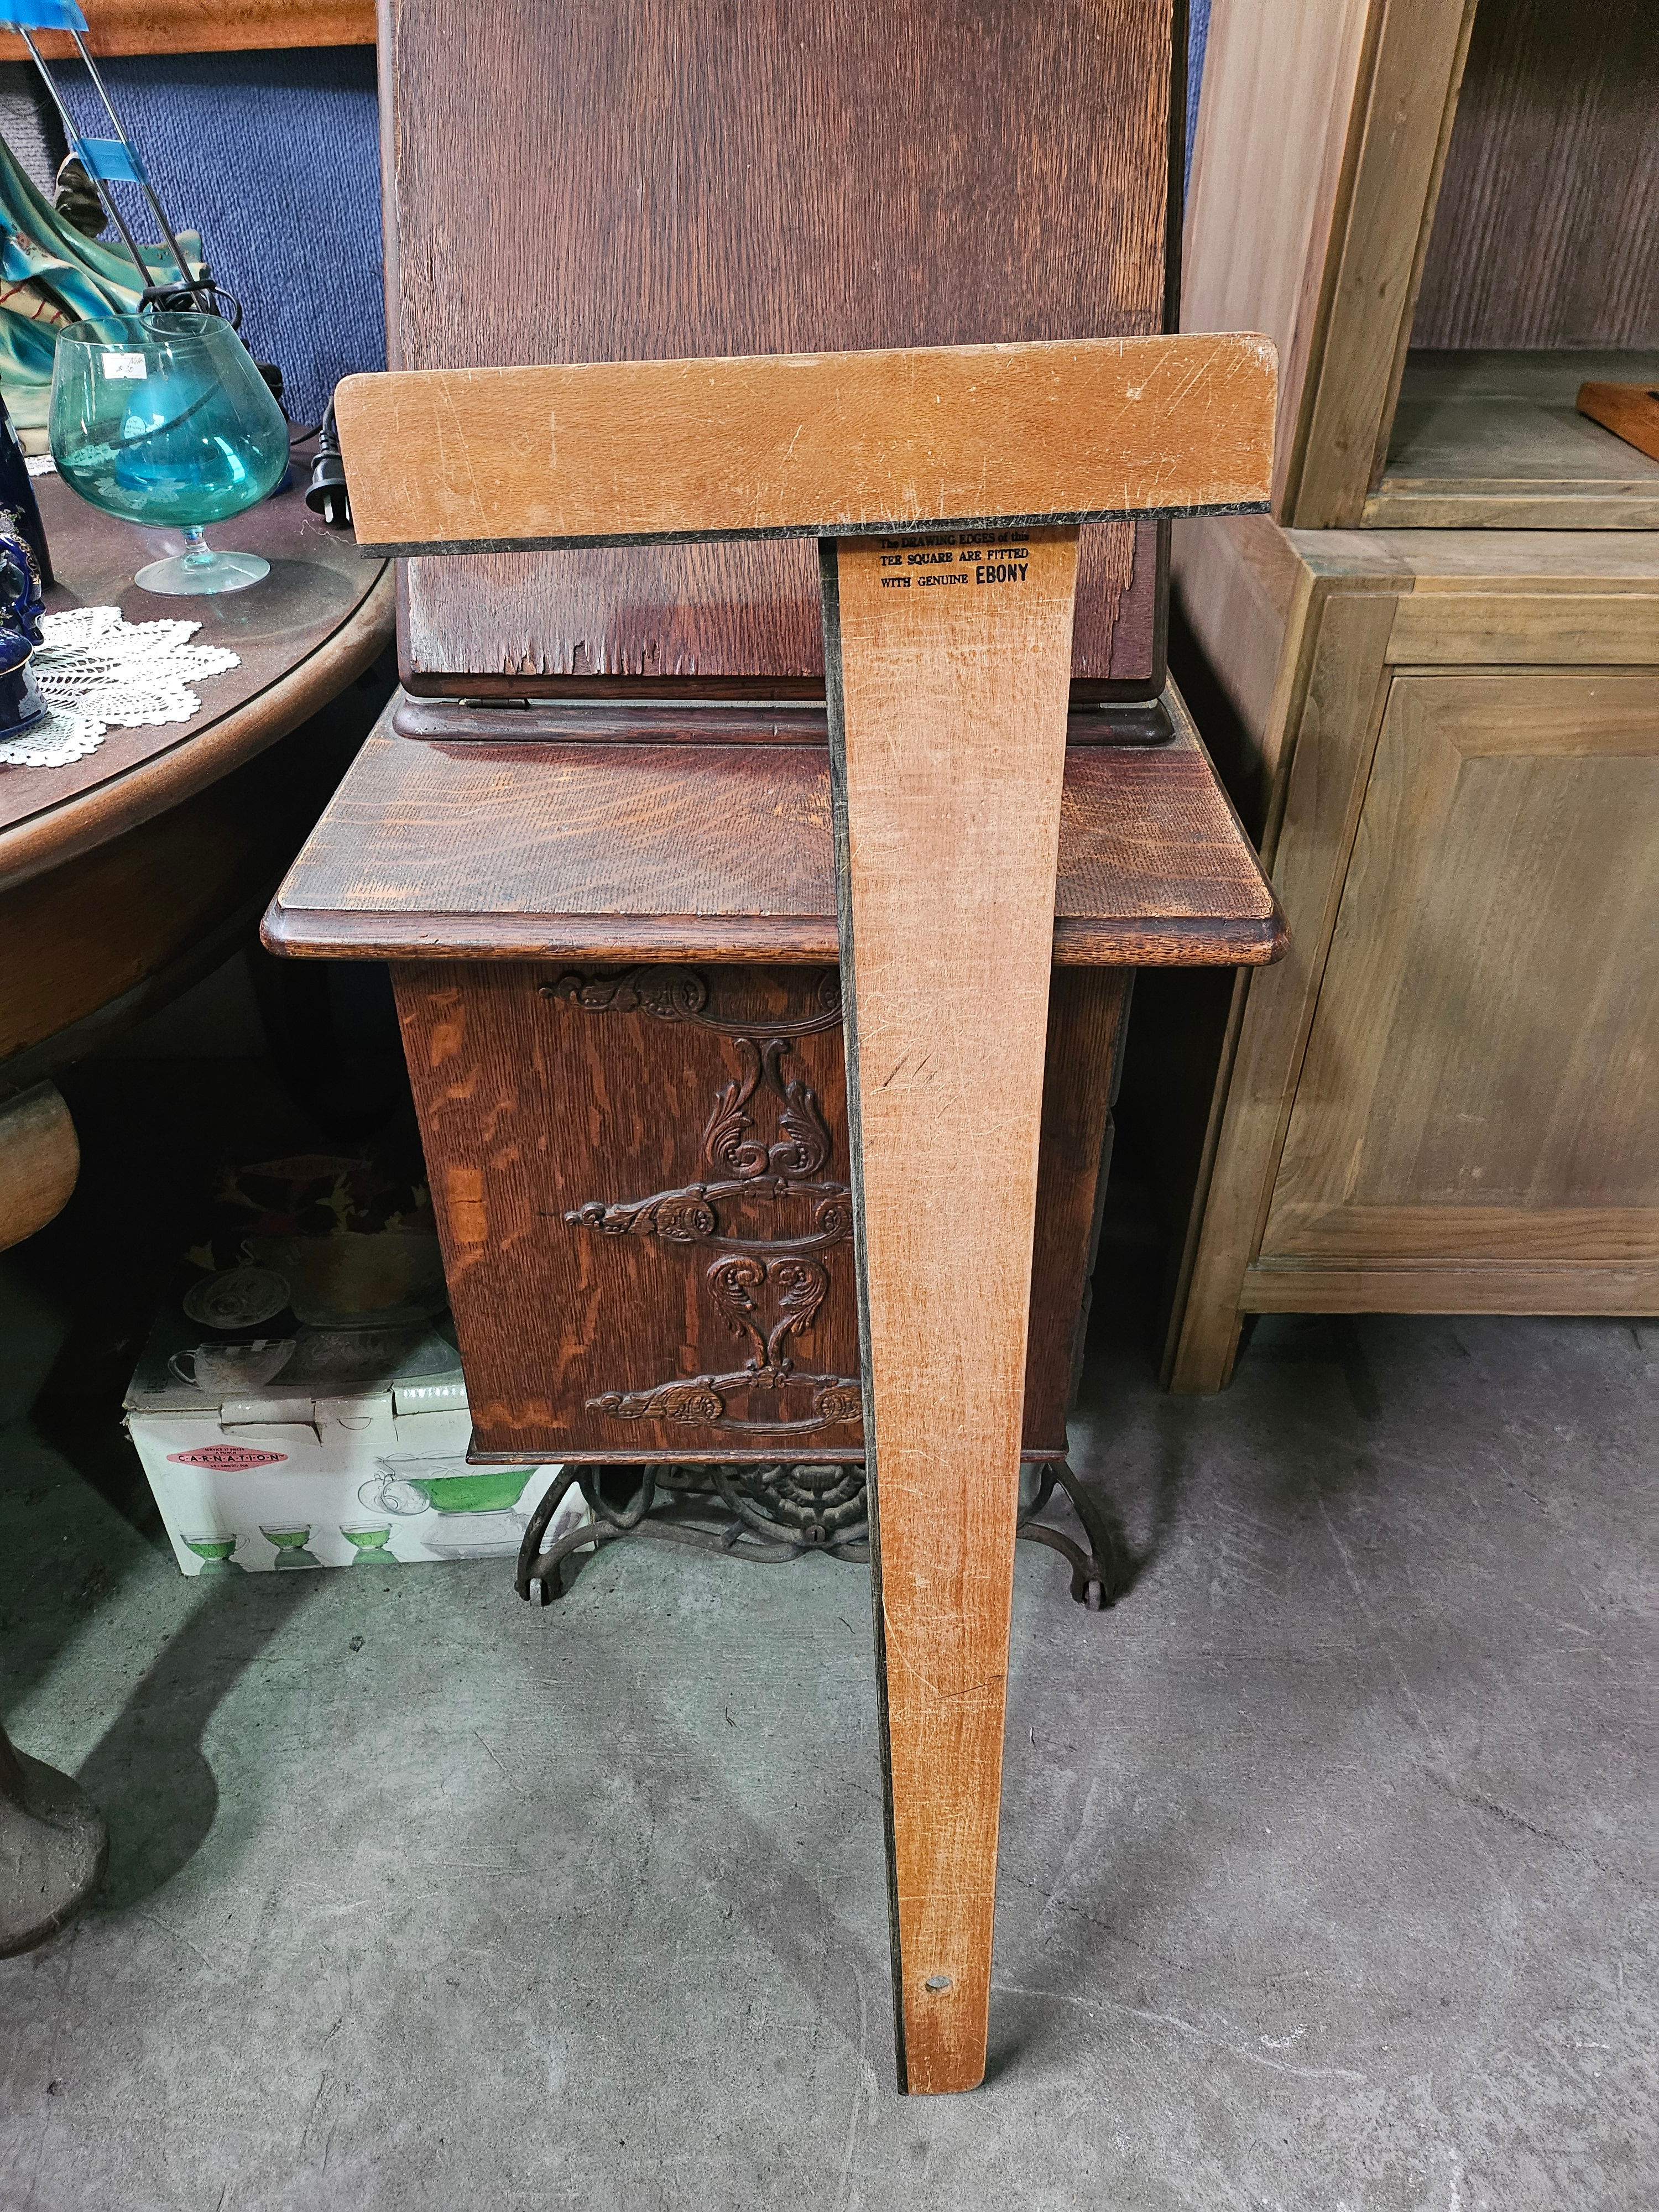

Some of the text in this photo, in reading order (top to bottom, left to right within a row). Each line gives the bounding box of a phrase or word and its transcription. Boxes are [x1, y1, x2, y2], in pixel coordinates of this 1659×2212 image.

[880, 531, 1029, 549] The DRAWING EDGES of this
[880, 547, 1029, 566] TEE SQUARE ARE FITTED
[881, 562, 1029, 588] WITH GENUINE EBONY
